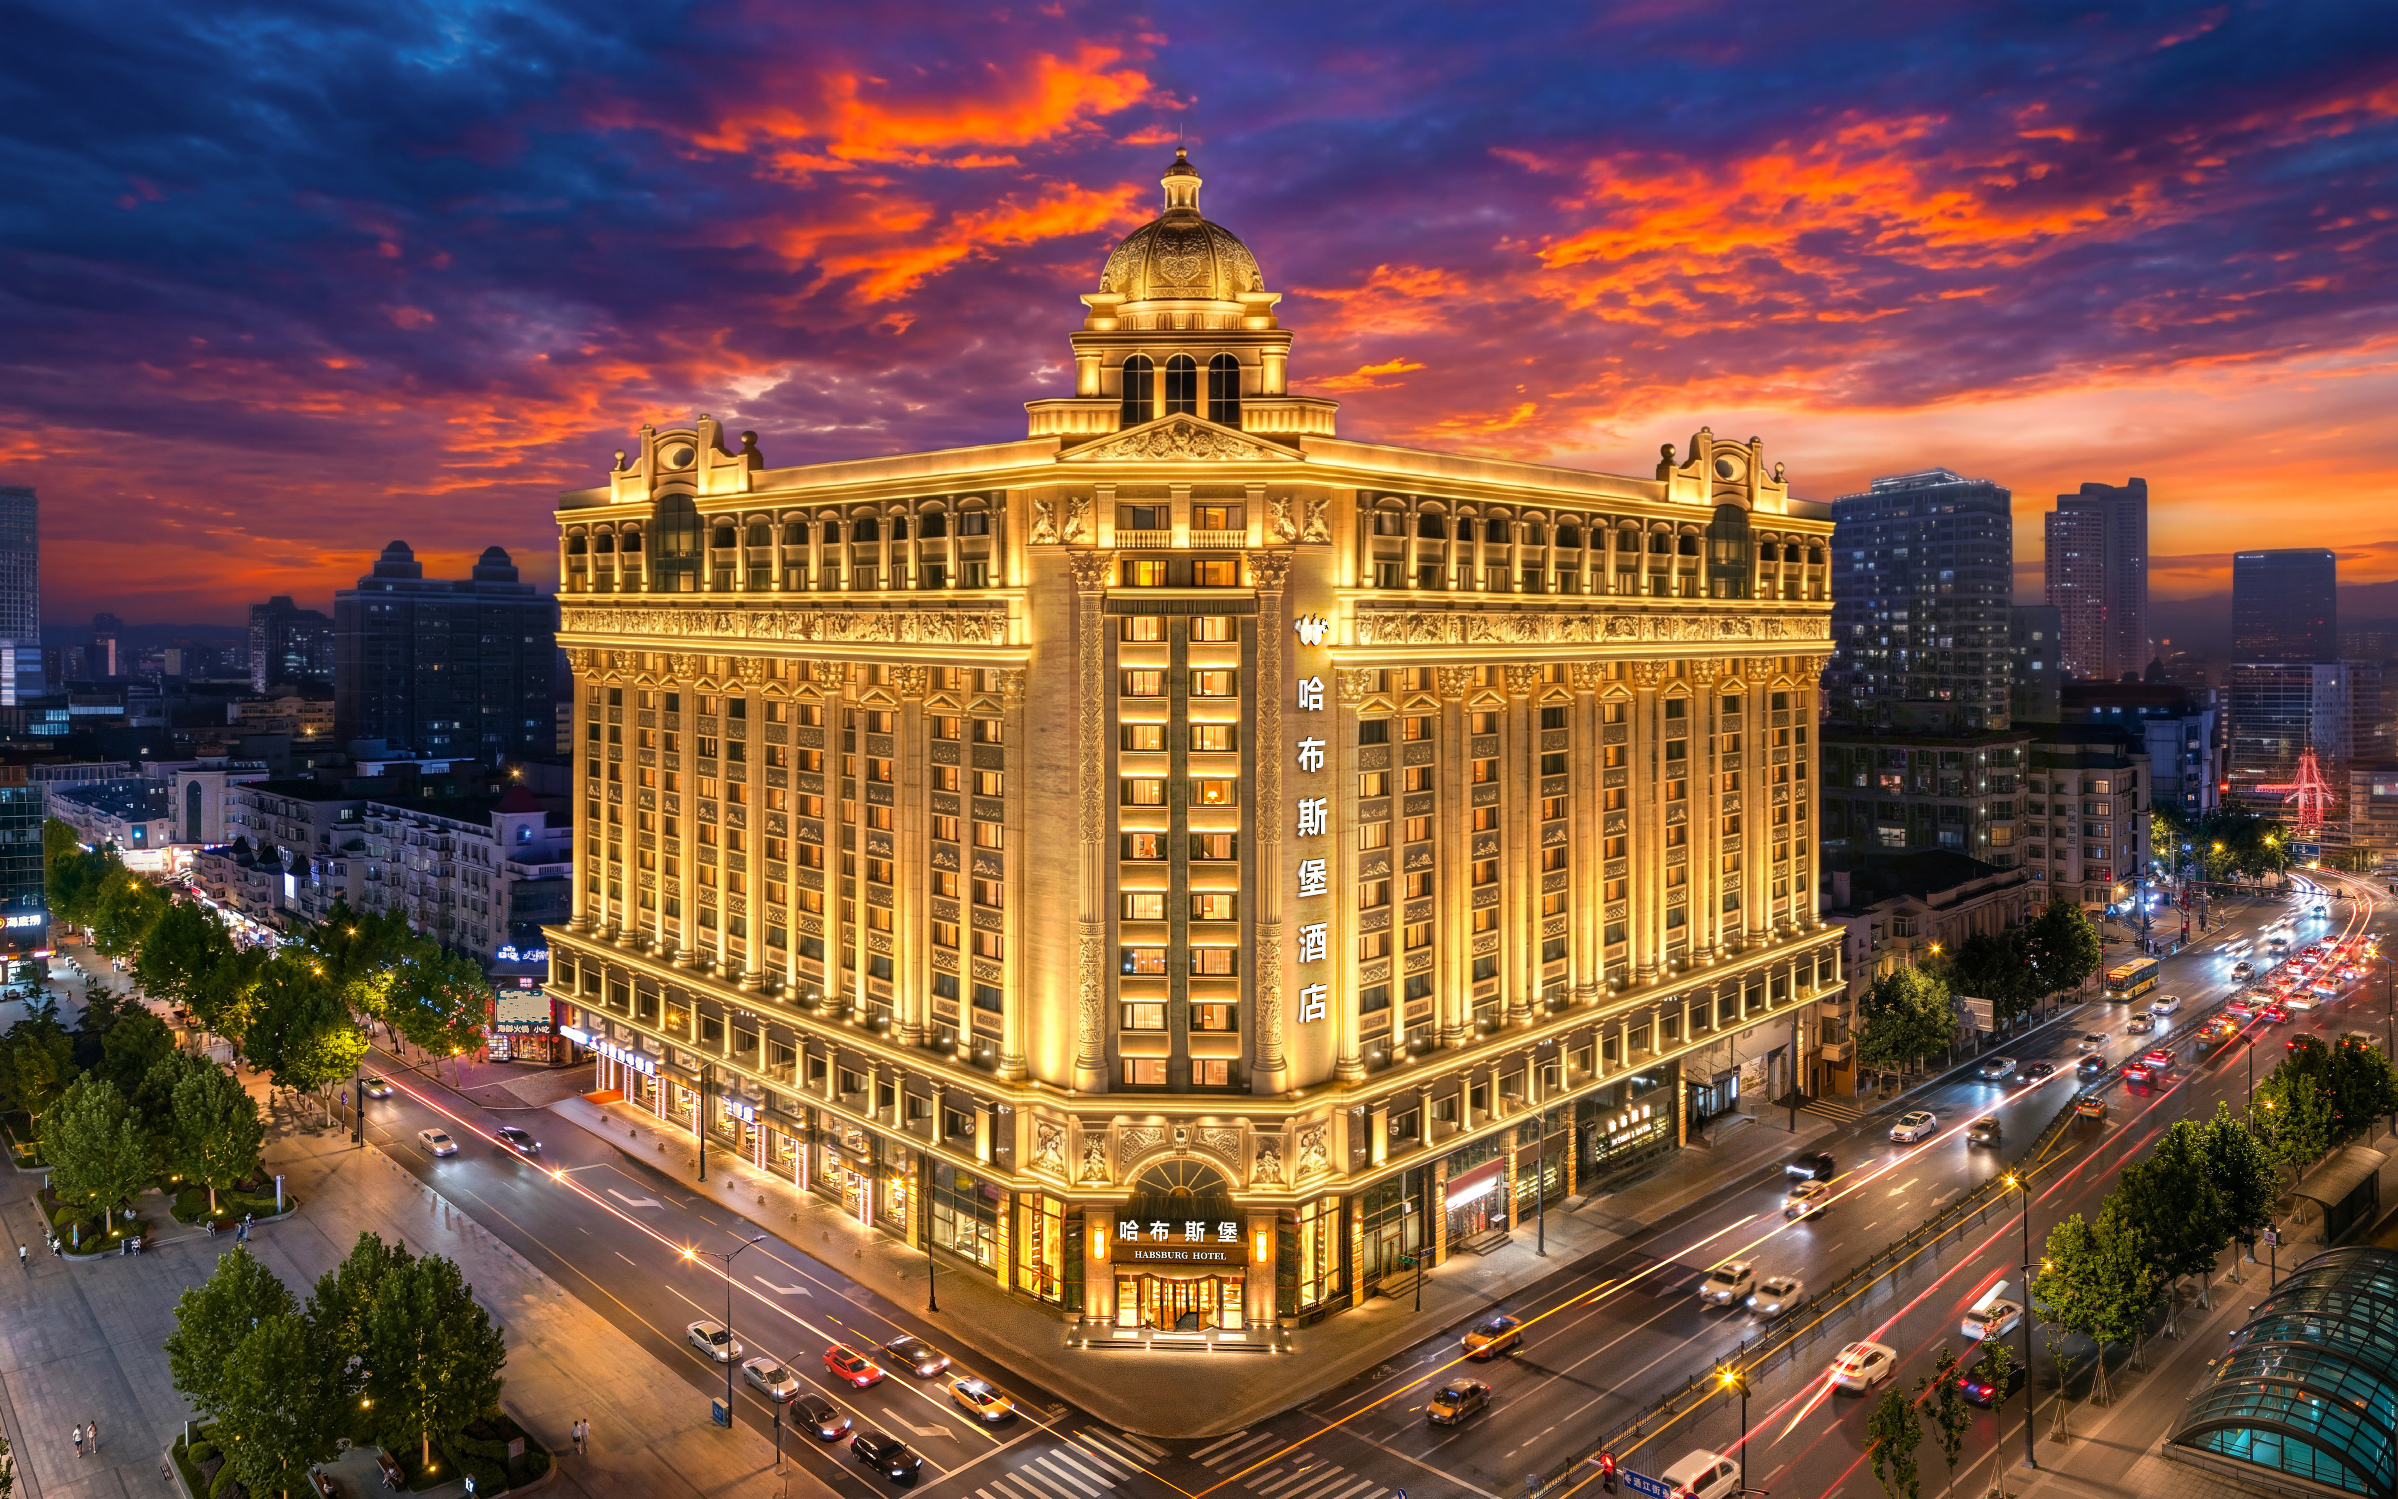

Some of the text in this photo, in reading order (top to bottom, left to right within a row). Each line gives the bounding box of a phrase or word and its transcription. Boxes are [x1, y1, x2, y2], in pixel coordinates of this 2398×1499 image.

[1297, 675, 1328, 1024] 哈布斯堡酒店
[1119, 1220, 1238, 1242] 哈布斯堡
[1134, 1250, 1227, 1261] HABSBURG HOTEL
